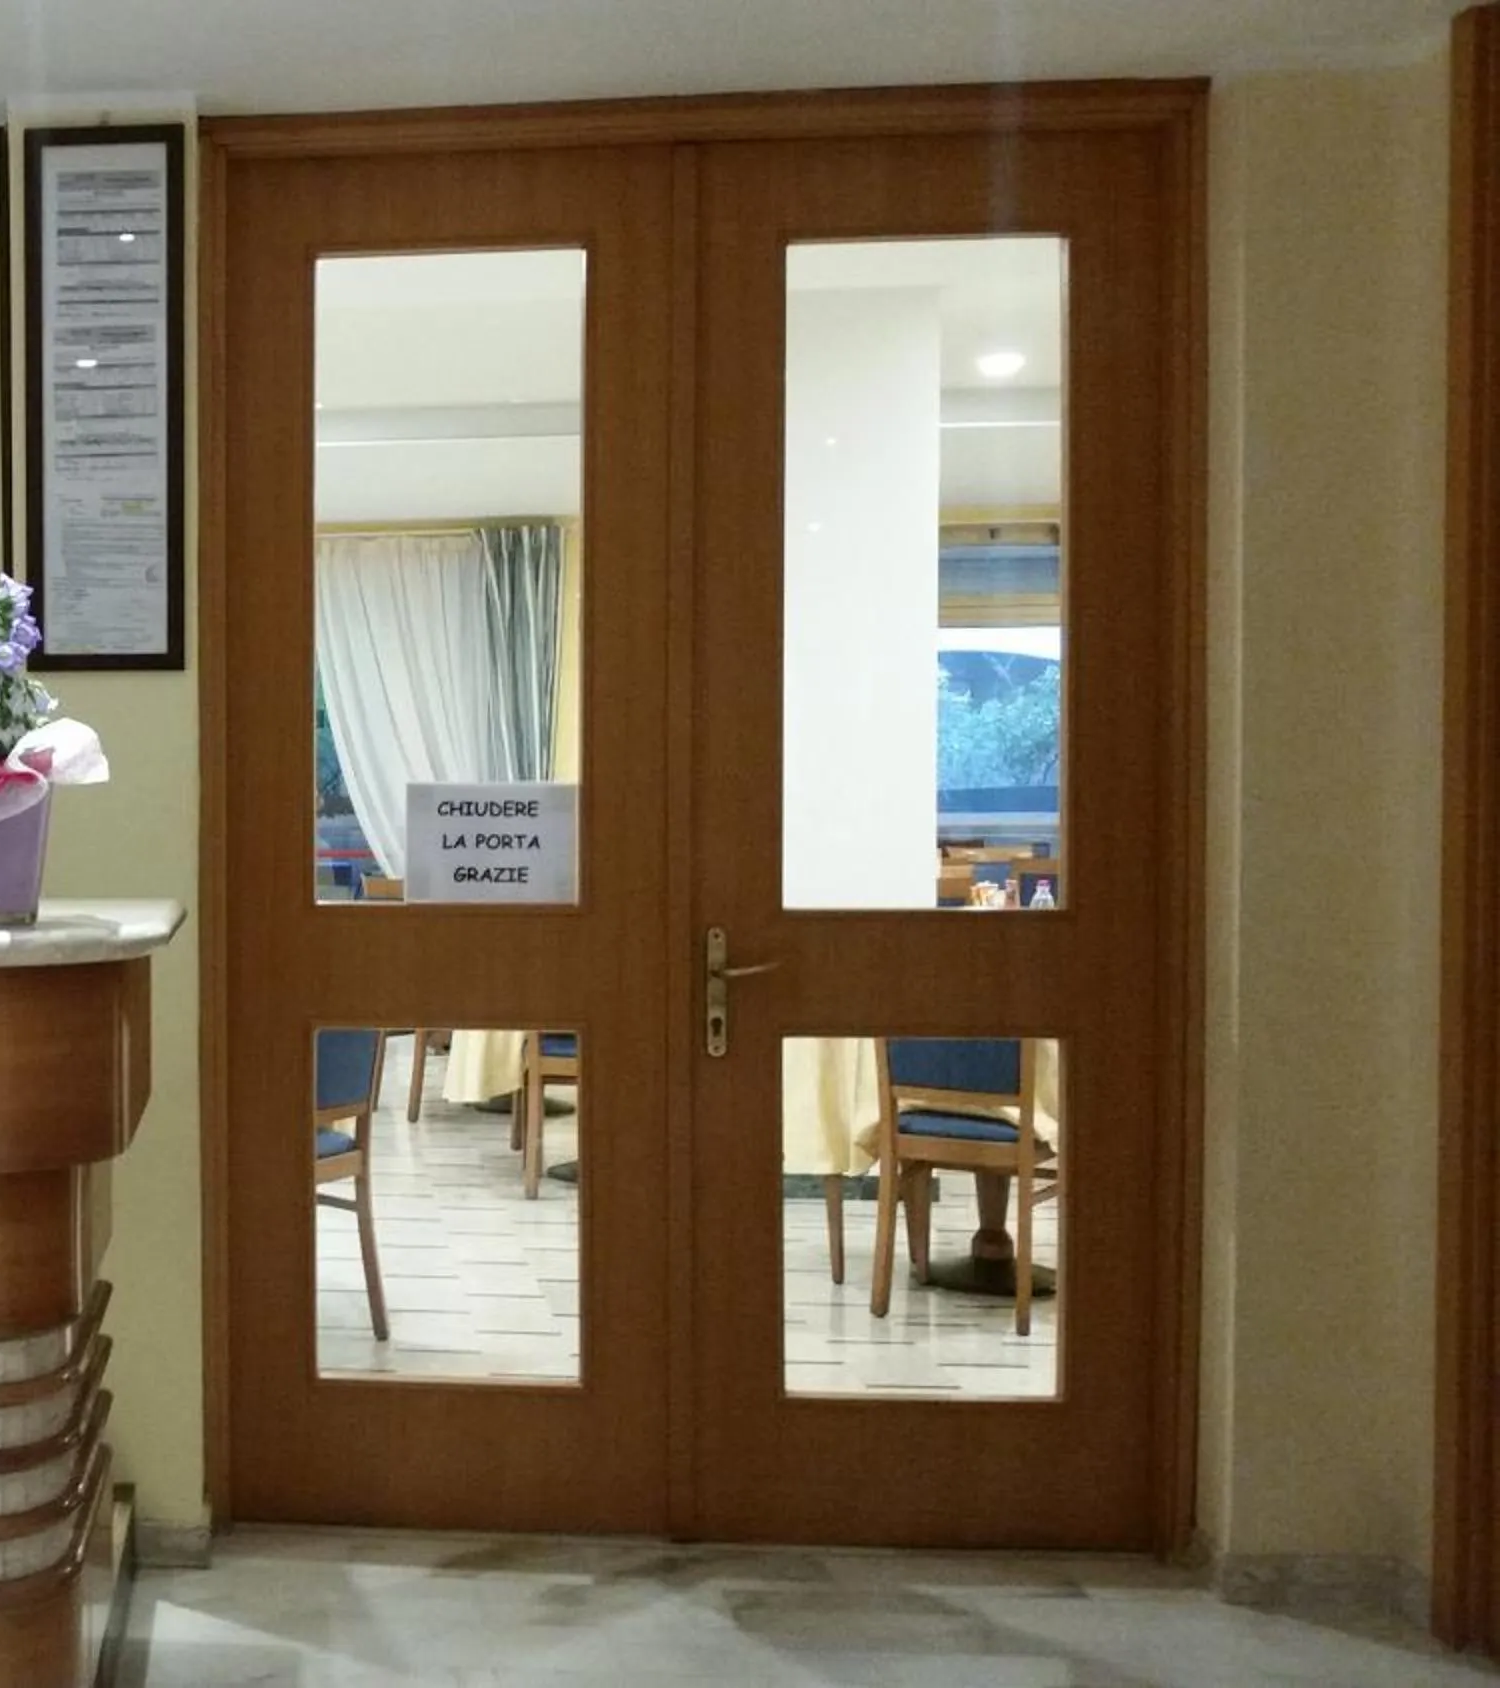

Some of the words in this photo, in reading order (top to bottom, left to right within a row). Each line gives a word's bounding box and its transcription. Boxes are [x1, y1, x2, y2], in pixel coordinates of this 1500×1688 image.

[437, 800, 540, 818] CHIUDERE
[442, 833, 467, 850] LA
[475, 833, 541, 850] PORTA
[453, 866, 530, 883] GRAZIE
